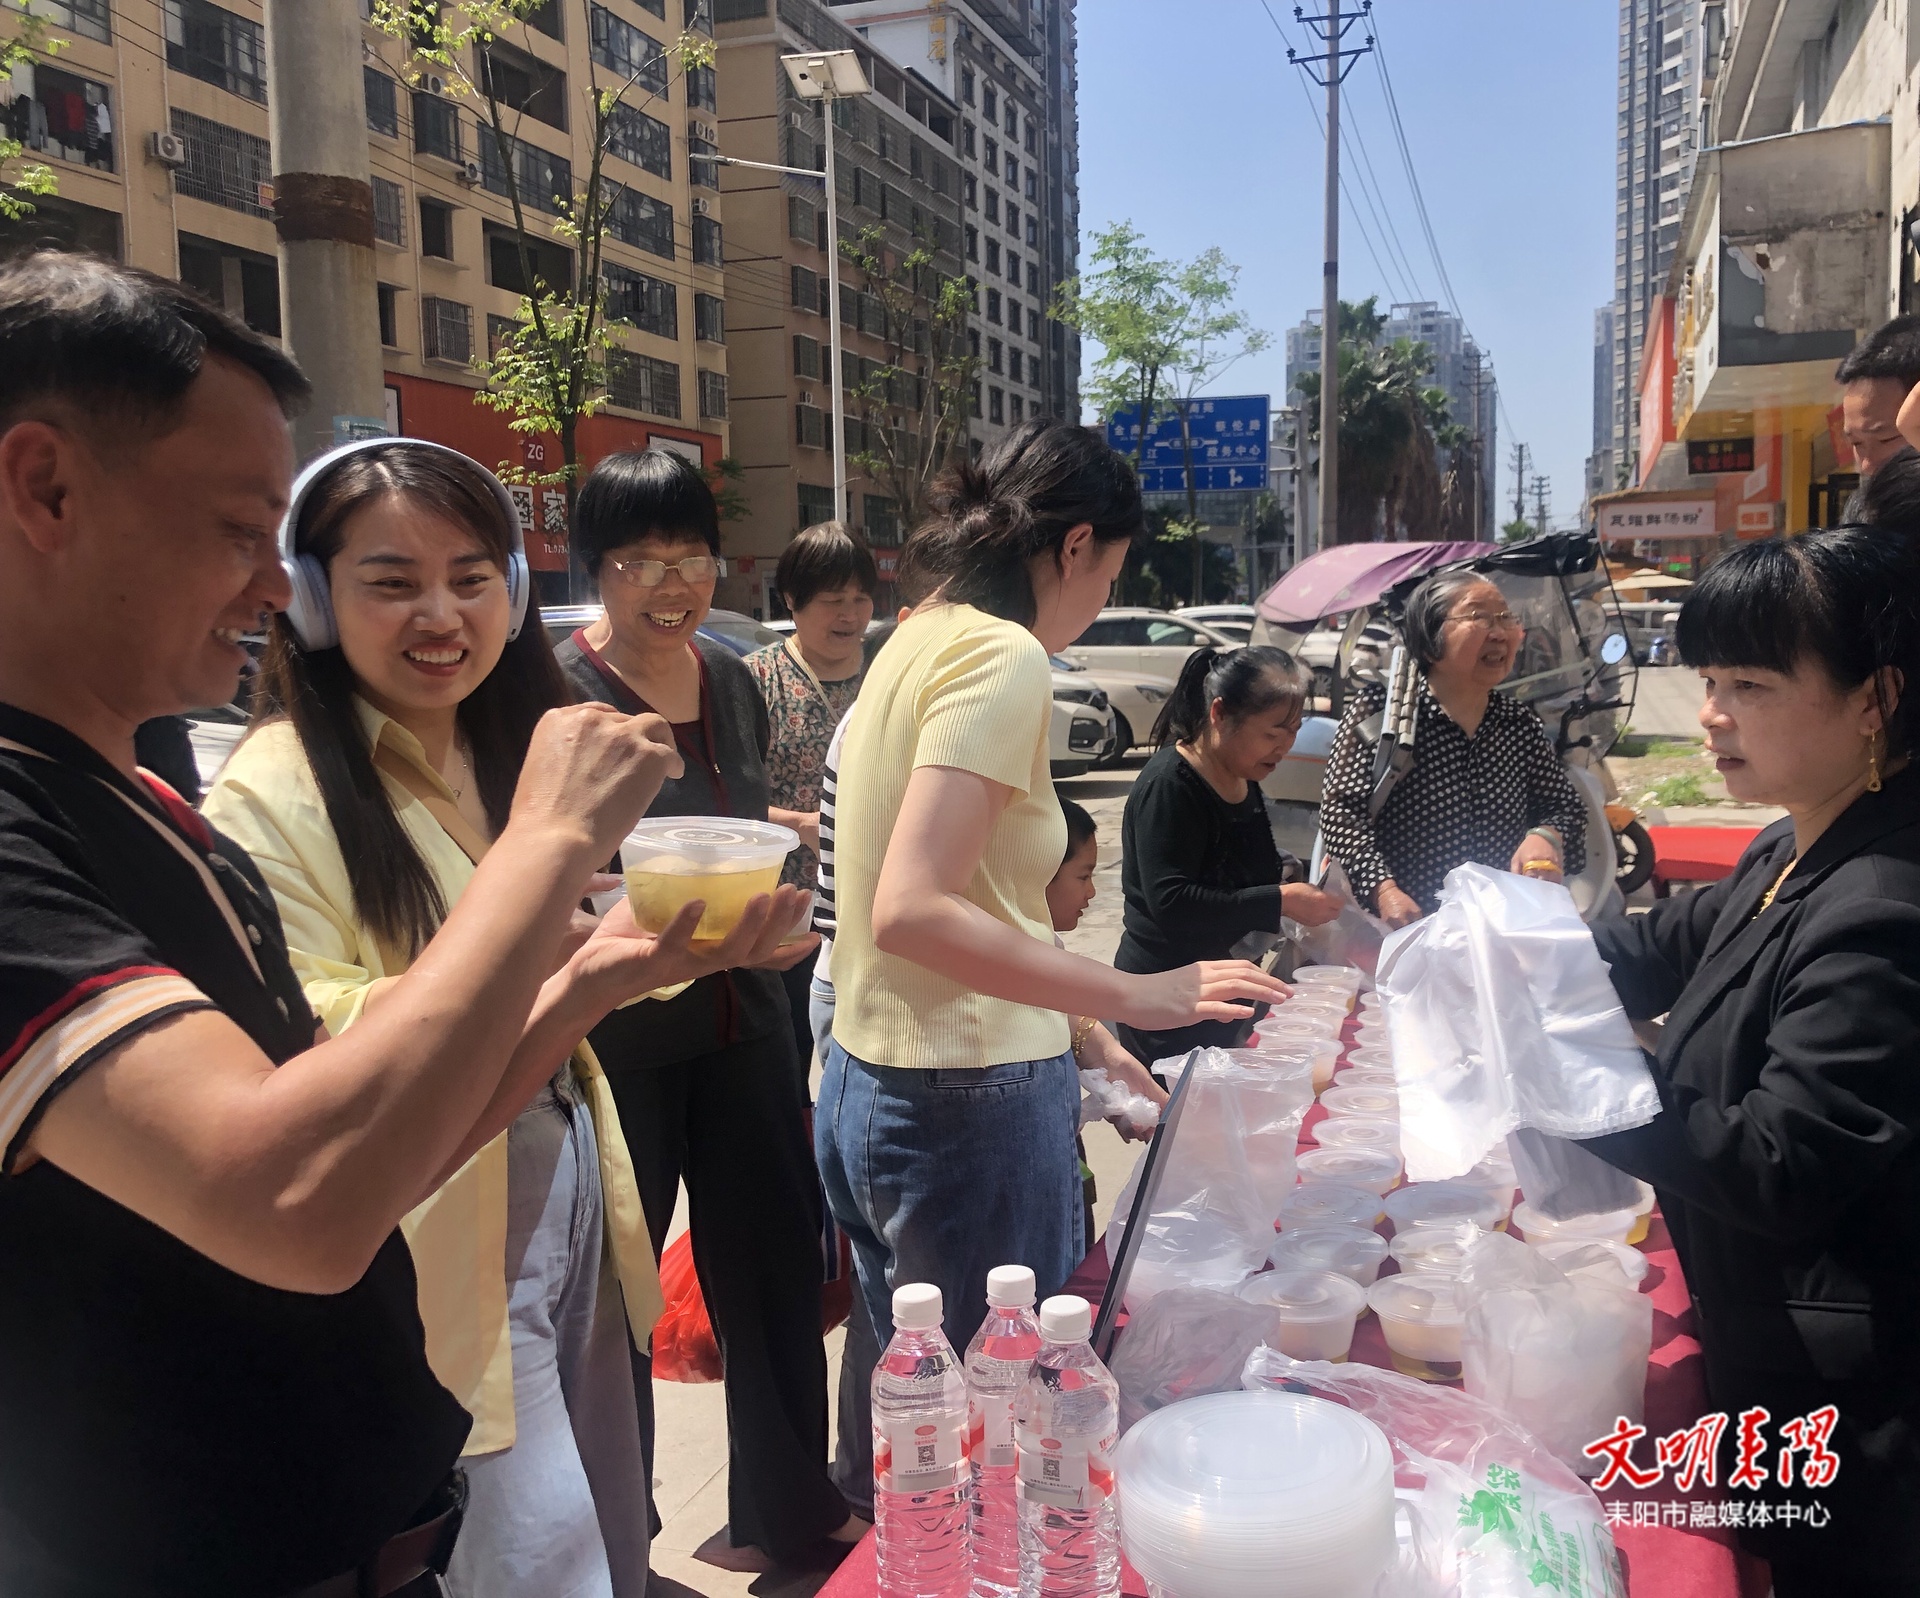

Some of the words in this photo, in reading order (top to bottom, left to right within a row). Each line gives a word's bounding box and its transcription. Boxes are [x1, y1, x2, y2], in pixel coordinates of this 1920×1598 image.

[527, 443, 544, 460] ZG
[1207, 445, 1261, 457] 政务中心
